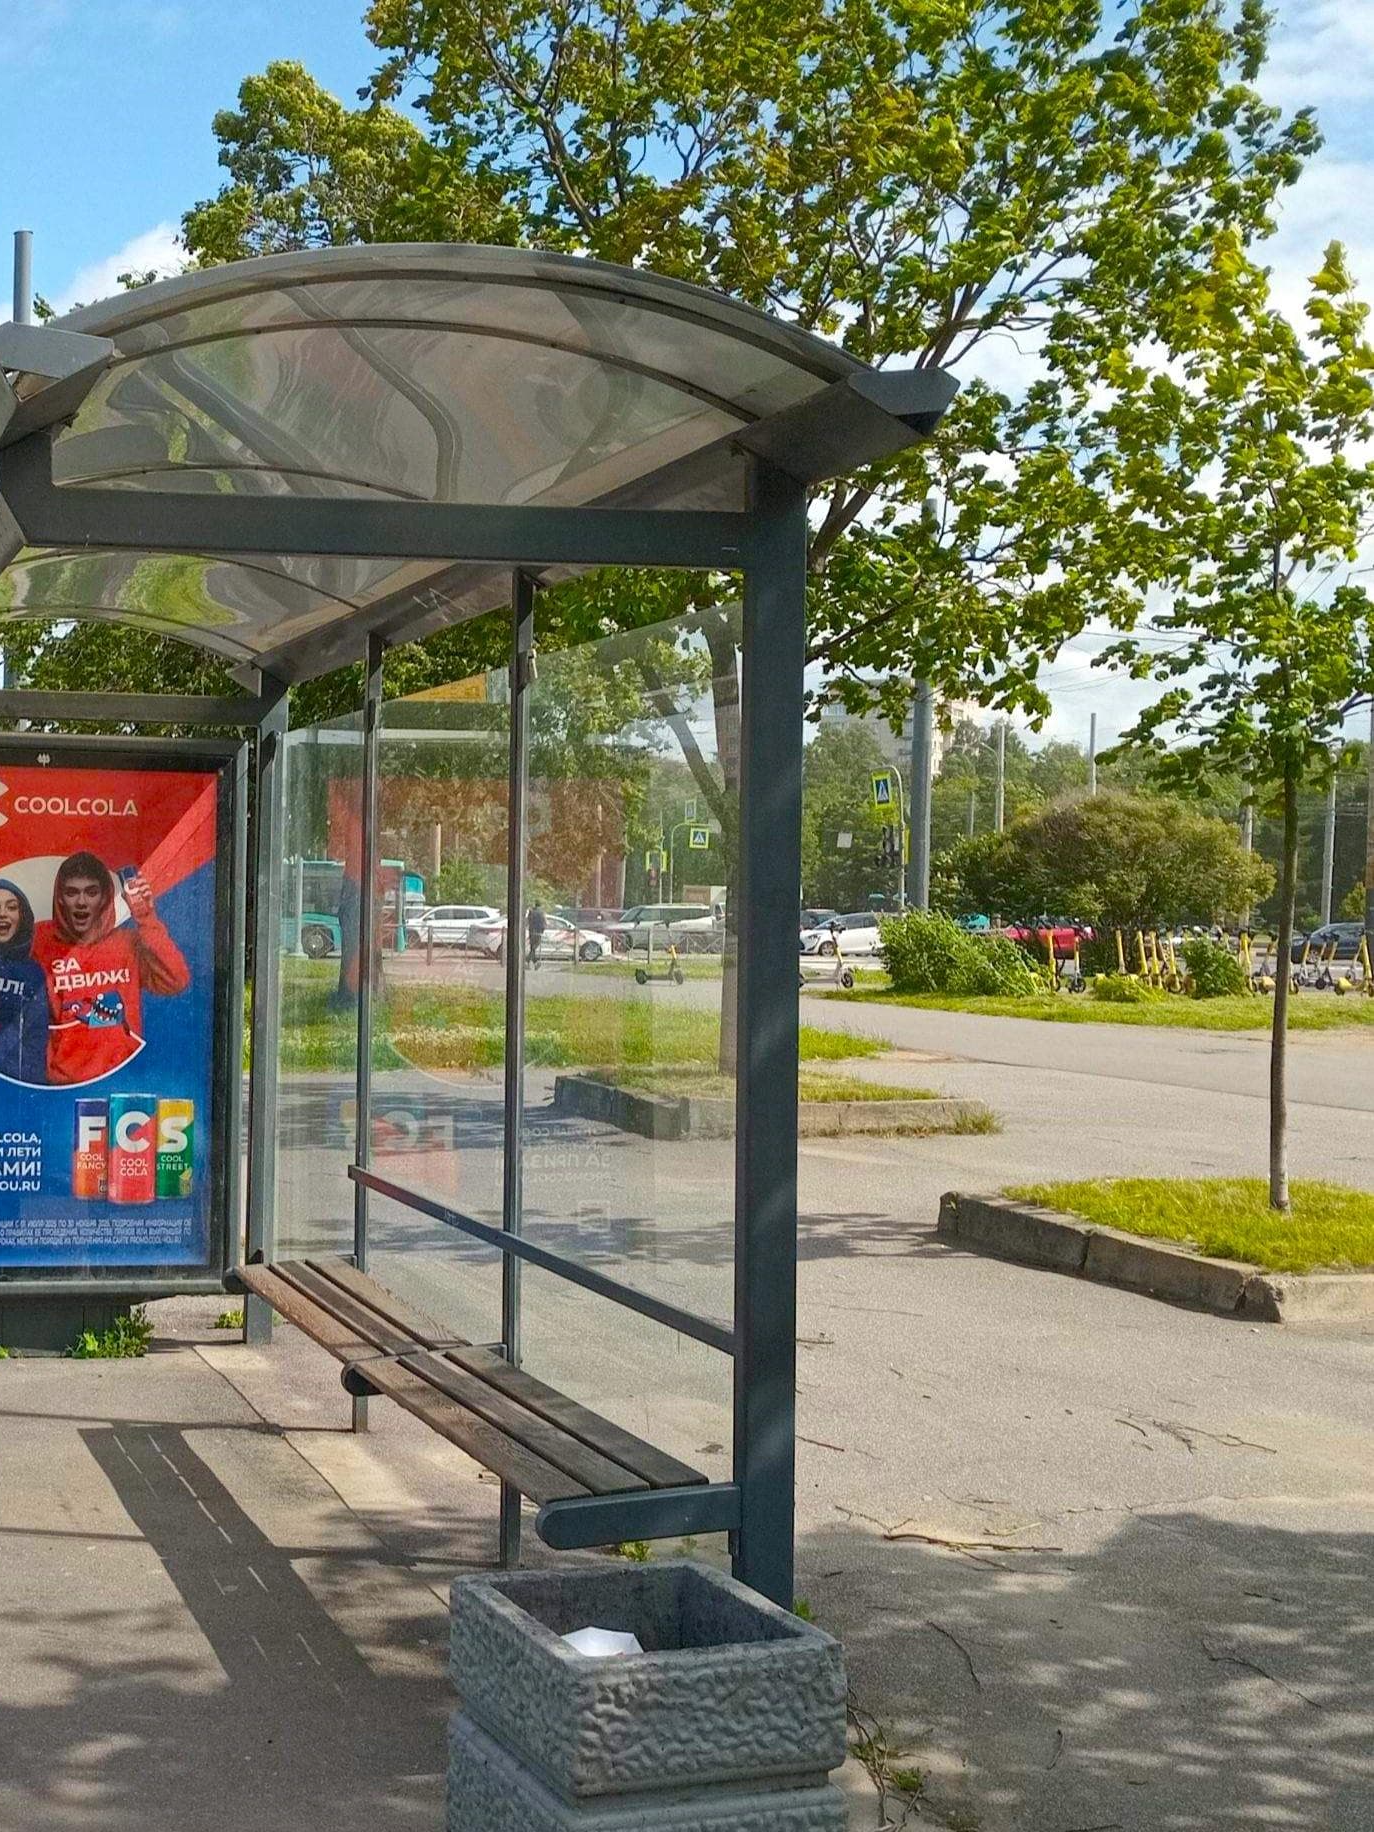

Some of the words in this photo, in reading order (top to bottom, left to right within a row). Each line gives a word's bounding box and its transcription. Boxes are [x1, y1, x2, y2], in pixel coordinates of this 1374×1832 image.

[14, 796, 138, 816] COOLCOLA
[51, 957, 82, 974] ЗА
[53, 968, 130, 993] ДВИЖ!
[79, 1115, 107, 1153] F
[115, 1110, 151, 1153] C
[157, 1116, 188, 1153] S
[7, 1147, 41, 1157] ЛЕТИ
[79, 1153, 104, 1161] COOL
[160, 1154, 184, 1163] COOL
[77, 1161, 106, 1170] FANCY
[120, 1158, 148, 1167] COOL
[119, 1167, 148, 1176] COLA
